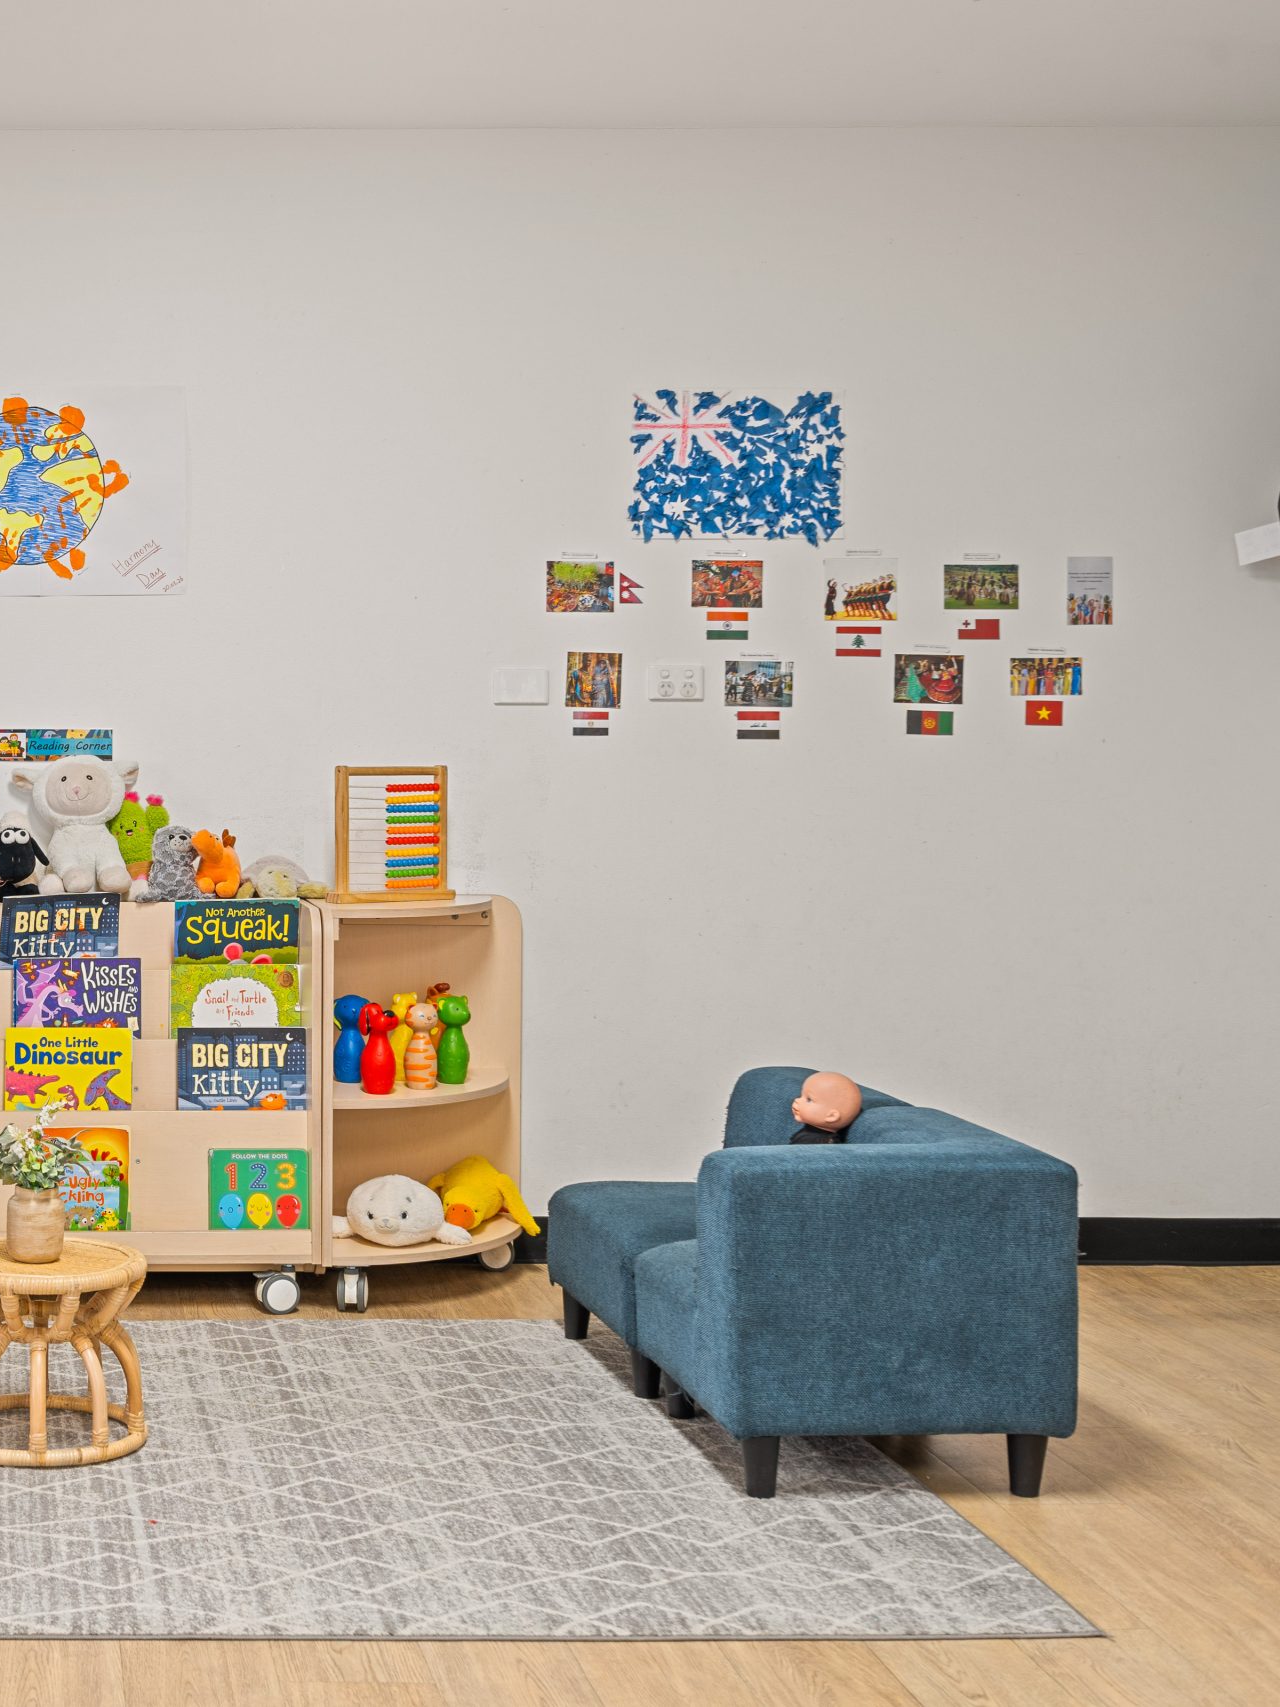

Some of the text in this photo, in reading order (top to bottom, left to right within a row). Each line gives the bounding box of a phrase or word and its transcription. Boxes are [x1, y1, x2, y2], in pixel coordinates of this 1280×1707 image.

[112, 540, 157, 574] Harmony
[136, 568, 164, 586] Day
[29, 740, 112, 752] Reading Corner
[15, 907, 103, 933] BIG CITY
[186, 914, 290, 945] Squeak!
[12, 934, 74, 958] Kitty
[205, 989, 228, 1004] Snail
[239, 990, 267, 1004] Turtle
[226, 1005, 255, 1020] Friends
[14, 1042, 123, 1065] Dinosaur
[39, 1037, 98, 1048] One Little
[192, 1043, 288, 1068] BIG CITY
[192, 1070, 260, 1101] Kitty
[68, 1175, 100, 1190] Ugly
[224, 1162, 296, 1190] 1 2 3
